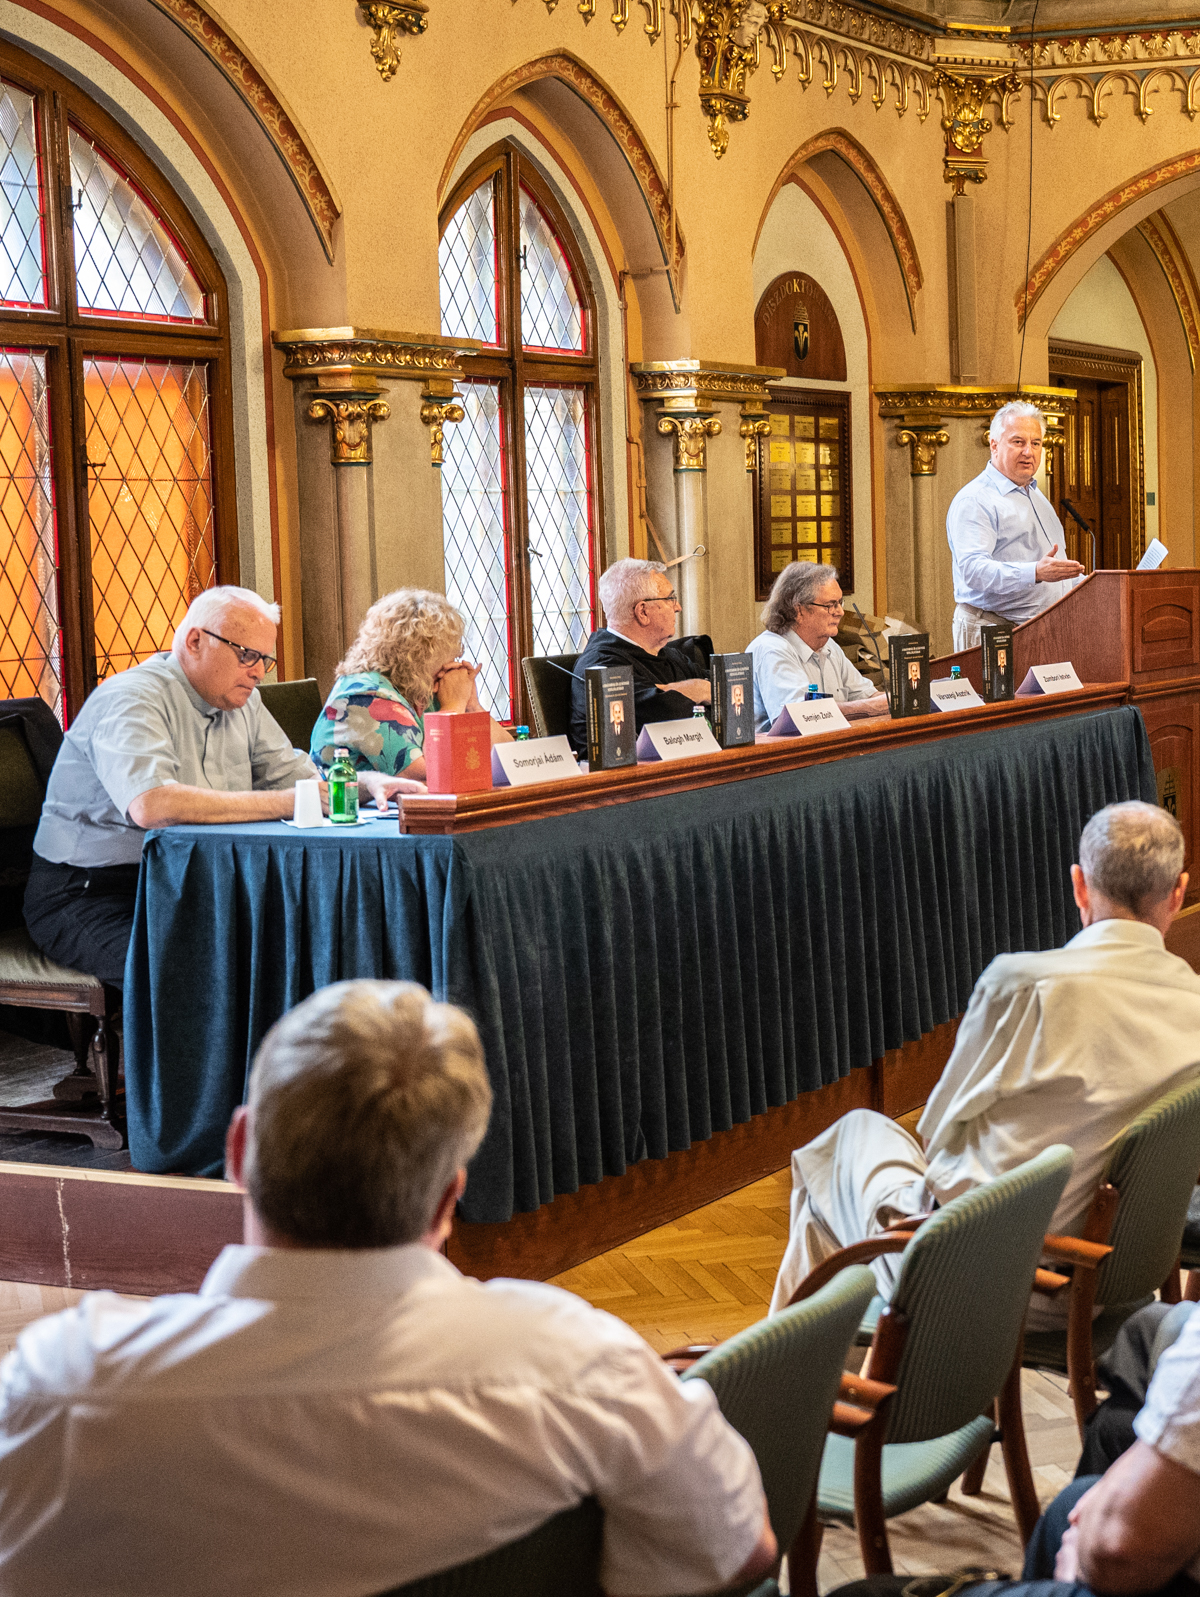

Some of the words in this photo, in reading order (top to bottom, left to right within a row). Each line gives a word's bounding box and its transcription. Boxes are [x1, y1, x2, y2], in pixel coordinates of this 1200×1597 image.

[802, 712, 822, 723] Semjén
[820, 710, 834, 720] Zsolt
[662, 734, 686, 746] Balogh
[683, 731, 704, 743] Margit
[513, 756, 544, 769] Somorjai
[543, 751, 565, 764] Ádám
